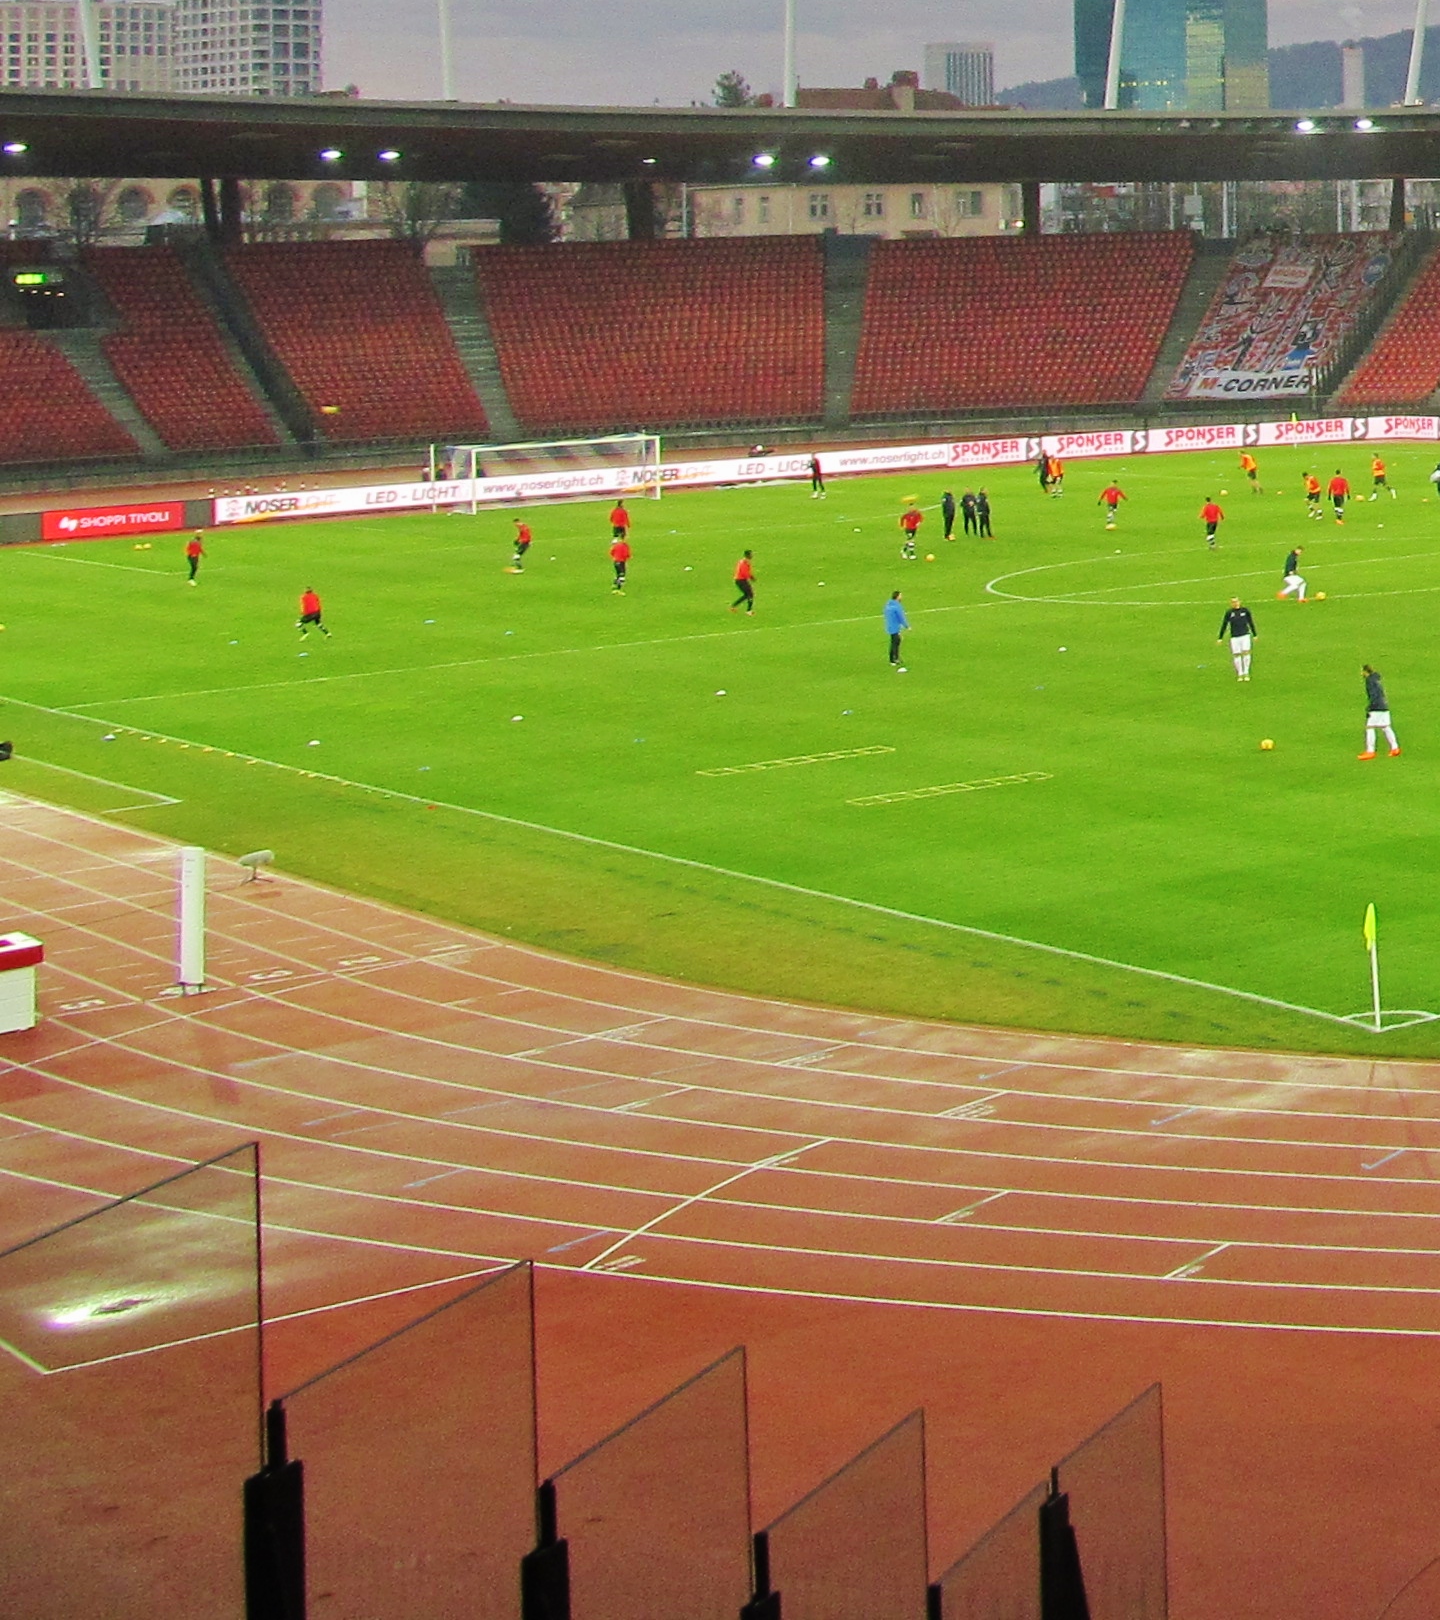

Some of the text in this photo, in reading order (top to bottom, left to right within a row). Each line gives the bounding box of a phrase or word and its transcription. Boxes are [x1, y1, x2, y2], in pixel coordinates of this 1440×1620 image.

[1275, 420, 1344, 440] SPONSER
[1384, 417, 1433, 434] SPONSER
[1057, 433, 1123, 454] SPONSER
[1165, 427, 1235, 447] SPONSER
[839, 449, 946, 467] www.noserlight.ch
[951, 441, 1019, 462] SPONSER
[737, 462, 765, 476] LED
[778, 459, 813, 474] LICH
[483, 474, 604, 494] www.noserlight.ch
[366, 489, 398, 505] LED
[412, 485, 460, 502] LICHT
[80, 511, 170, 529] SHOPPI TIVOLI
